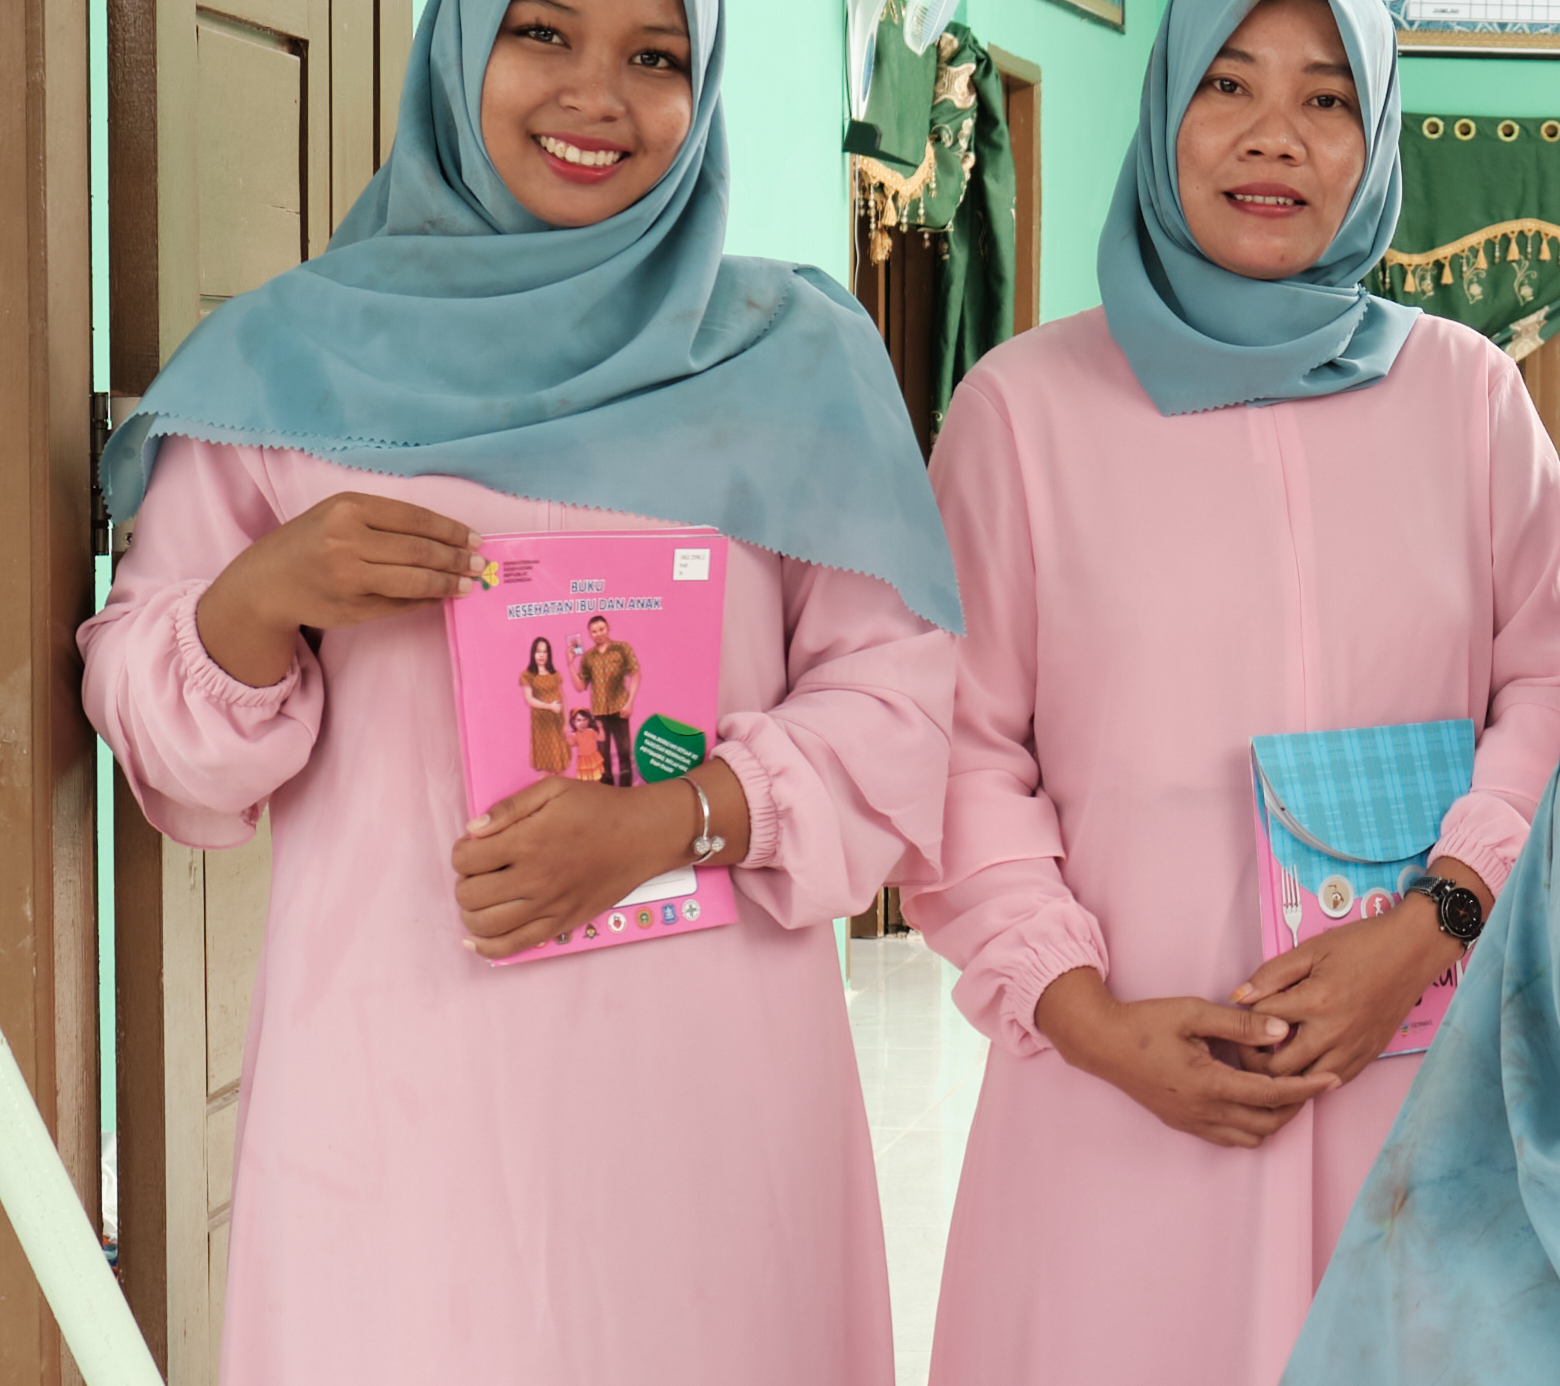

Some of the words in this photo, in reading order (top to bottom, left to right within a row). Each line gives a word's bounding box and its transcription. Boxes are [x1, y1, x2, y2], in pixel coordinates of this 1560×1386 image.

[570, 580, 605, 594] BUKU
[507, 600, 573, 620] KESEHATAN
[576, 599, 595, 612] IBU
[598, 598, 625, 611] DAN
[627, 597, 663, 611] ANAK
